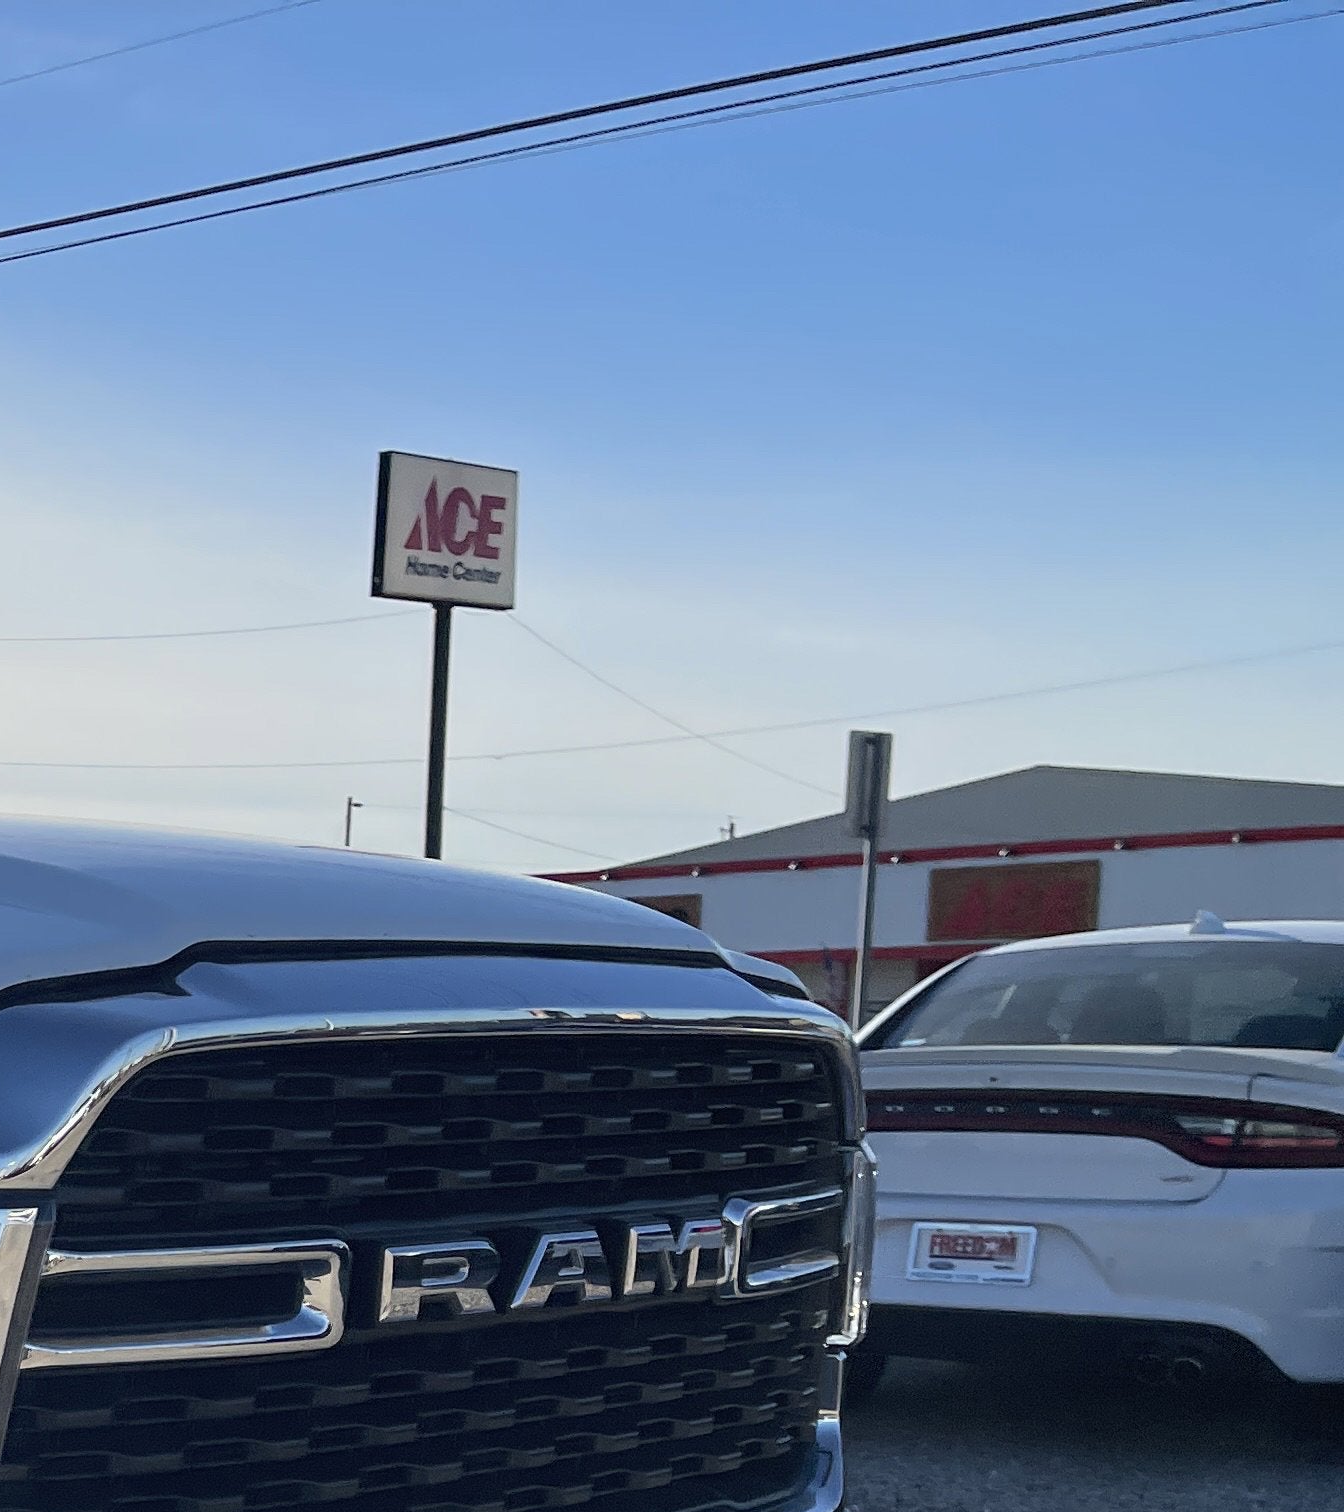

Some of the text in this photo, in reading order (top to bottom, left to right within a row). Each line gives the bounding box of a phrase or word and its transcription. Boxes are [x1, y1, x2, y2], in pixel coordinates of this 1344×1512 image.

[404, 474, 506, 560] ACE
[405, 556, 502, 585] Home Center
[378, 1218, 732, 1323] RAM
